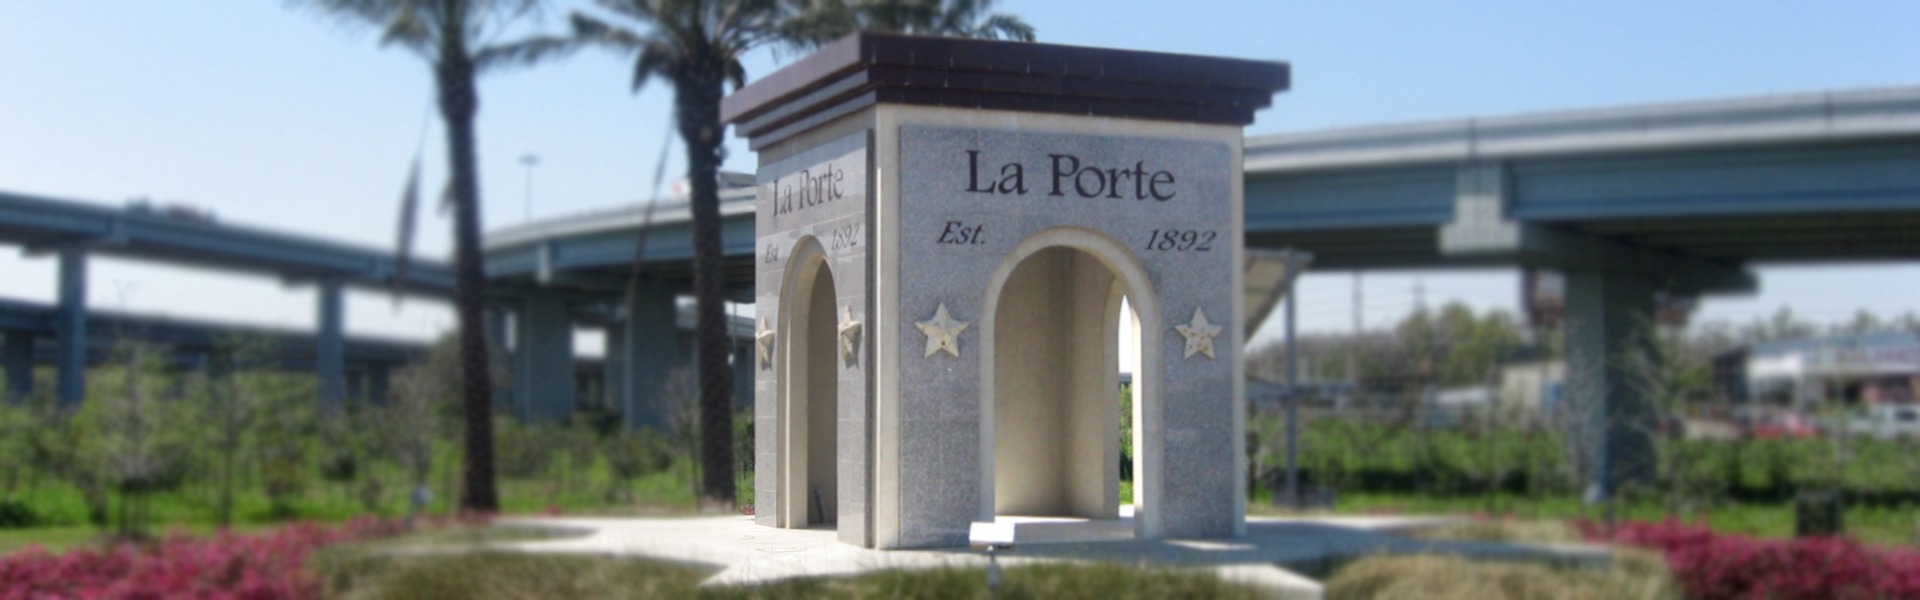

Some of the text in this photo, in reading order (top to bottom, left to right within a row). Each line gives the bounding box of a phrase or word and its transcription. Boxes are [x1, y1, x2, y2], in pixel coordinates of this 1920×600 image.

[772, 163, 845, 217] La Porte
[965, 150, 1176, 201] La Porte
[831, 221, 860, 251] 1892
[936, 221, 1217, 252] Est. 1892
